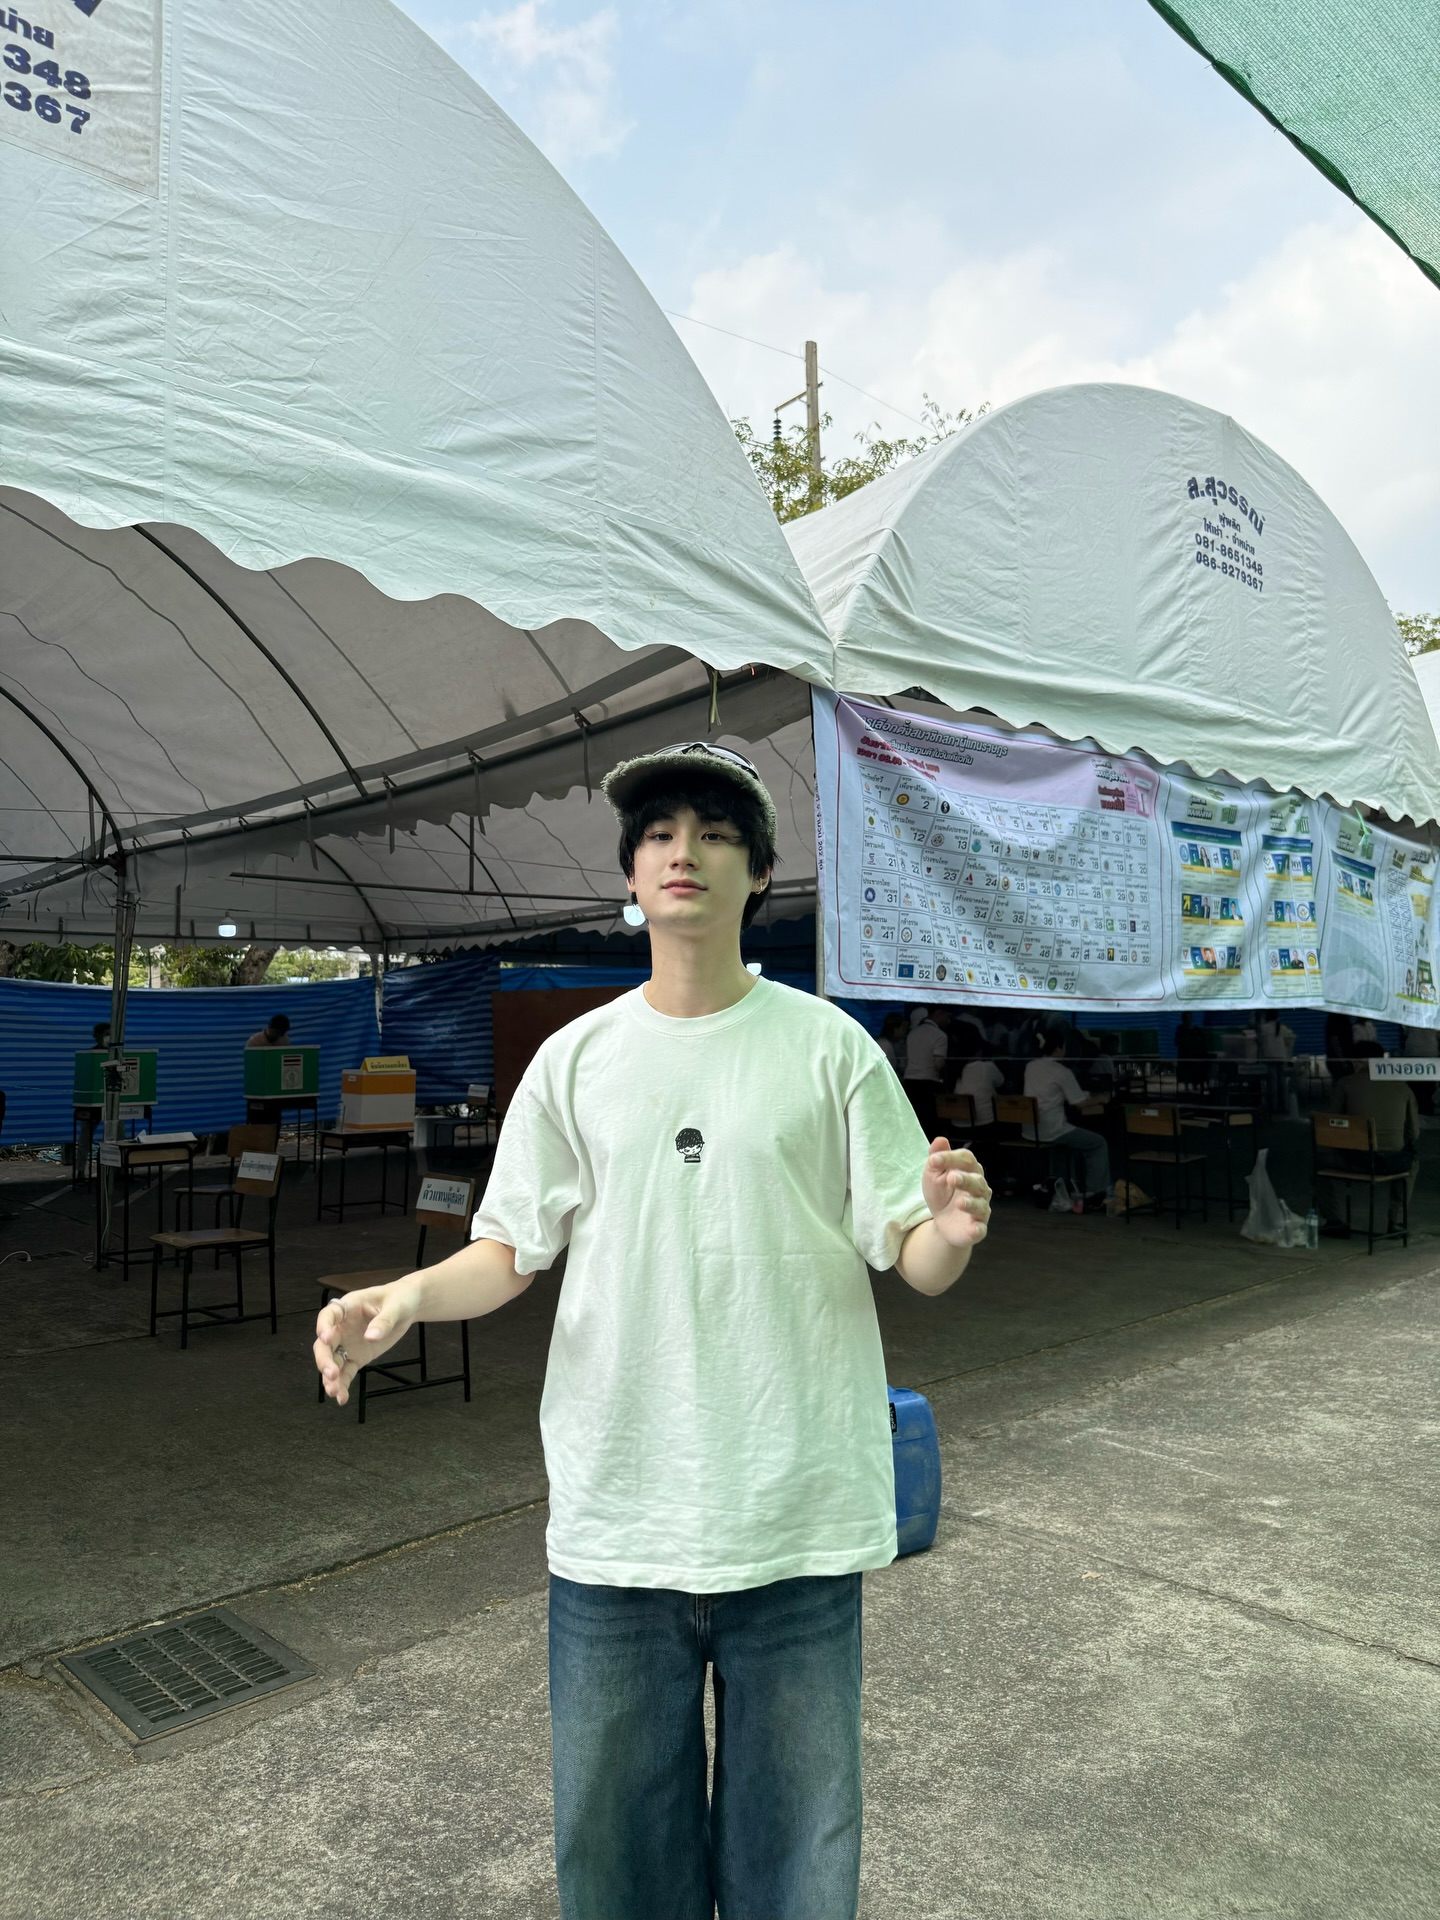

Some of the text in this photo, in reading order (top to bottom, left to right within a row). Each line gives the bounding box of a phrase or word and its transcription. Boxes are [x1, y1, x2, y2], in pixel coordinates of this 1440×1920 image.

[3, 43, 92, 100] 348
[0, 81, 91, 135] 367
[1195, 533, 1263, 576] 081-8651348
[1195, 551, 1263, 592] 086-8279367
[1375, 1062, 1436, 1076] ทางออก
